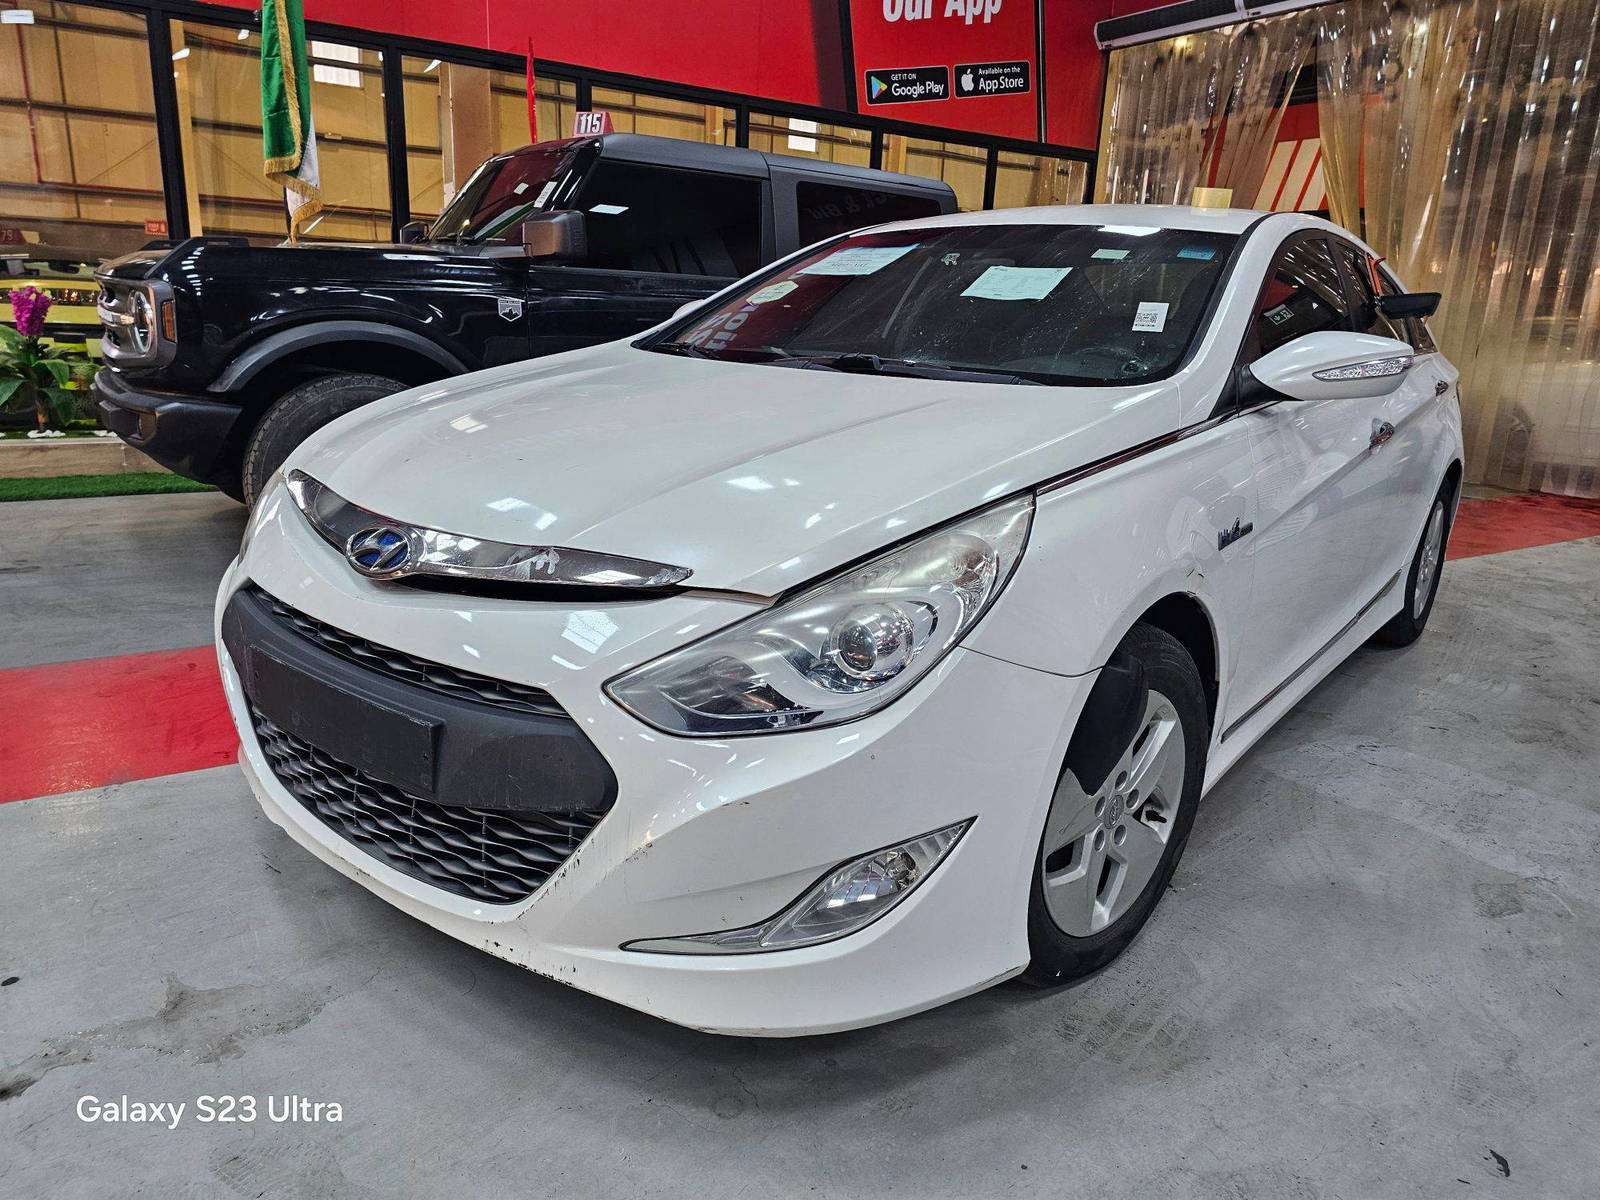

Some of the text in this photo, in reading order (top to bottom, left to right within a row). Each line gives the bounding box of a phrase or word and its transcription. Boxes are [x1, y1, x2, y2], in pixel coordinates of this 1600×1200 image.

[883, 0, 1001, 25] Our App
[979, 67, 1003, 75] Available
[892, 80, 944, 98] Google Play
[979, 75, 1024, 93] App Store
[580, 113, 601, 134] 115
